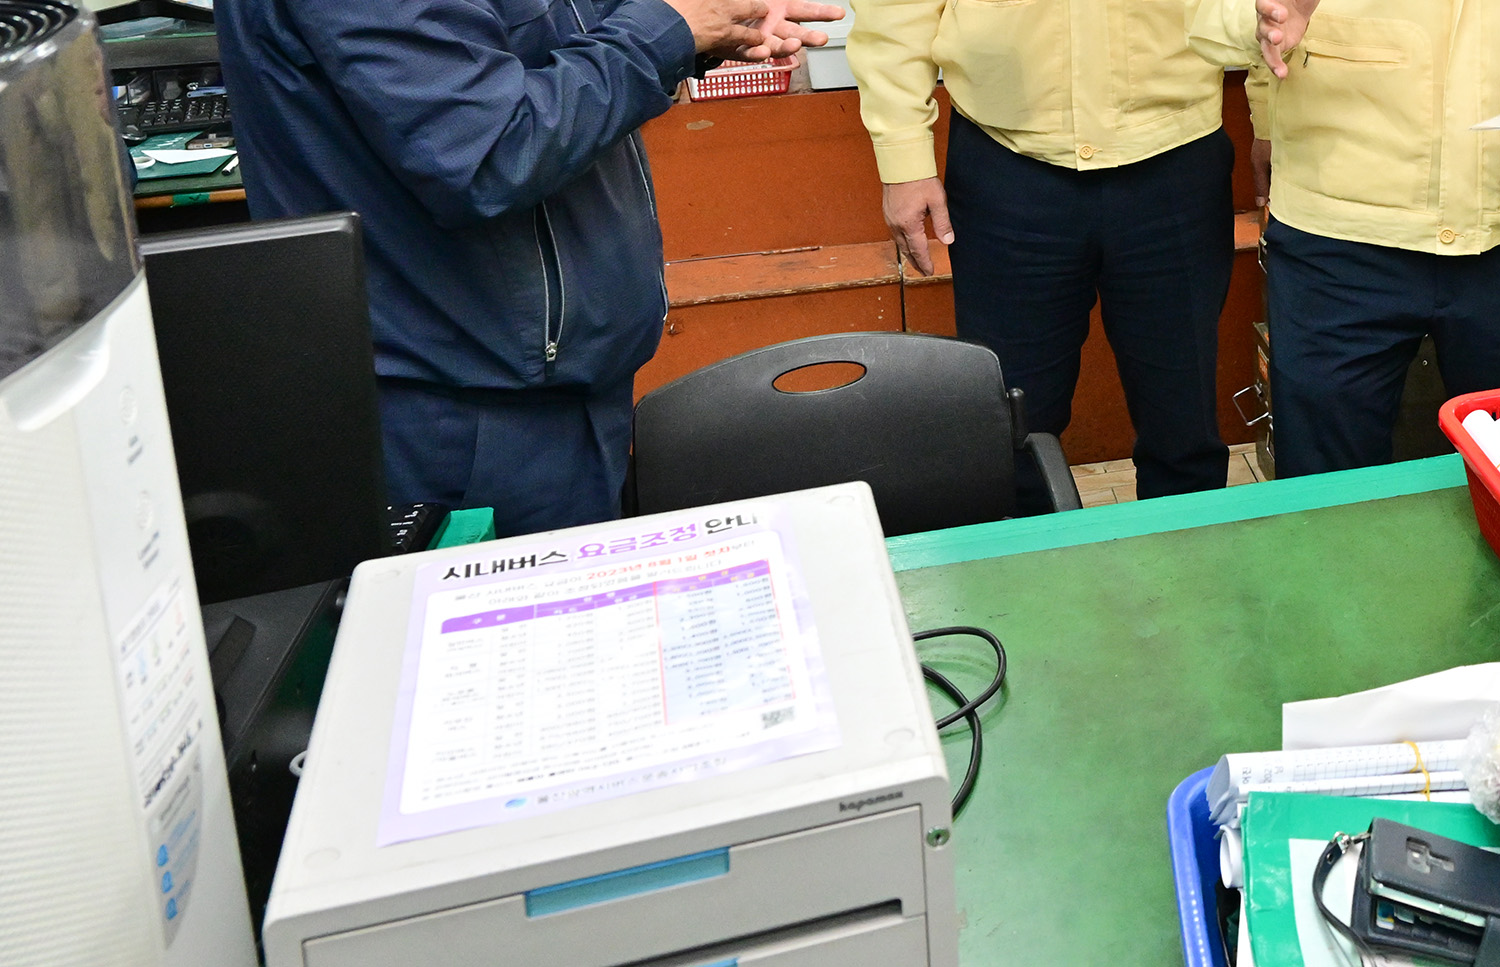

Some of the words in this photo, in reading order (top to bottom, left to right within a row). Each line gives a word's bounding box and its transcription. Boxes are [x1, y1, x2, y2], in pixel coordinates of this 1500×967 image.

[442, 550, 568, 580] 시내버스
[576, 523, 697, 559] 요금조정
[586, 563, 642, 581] 2023년
